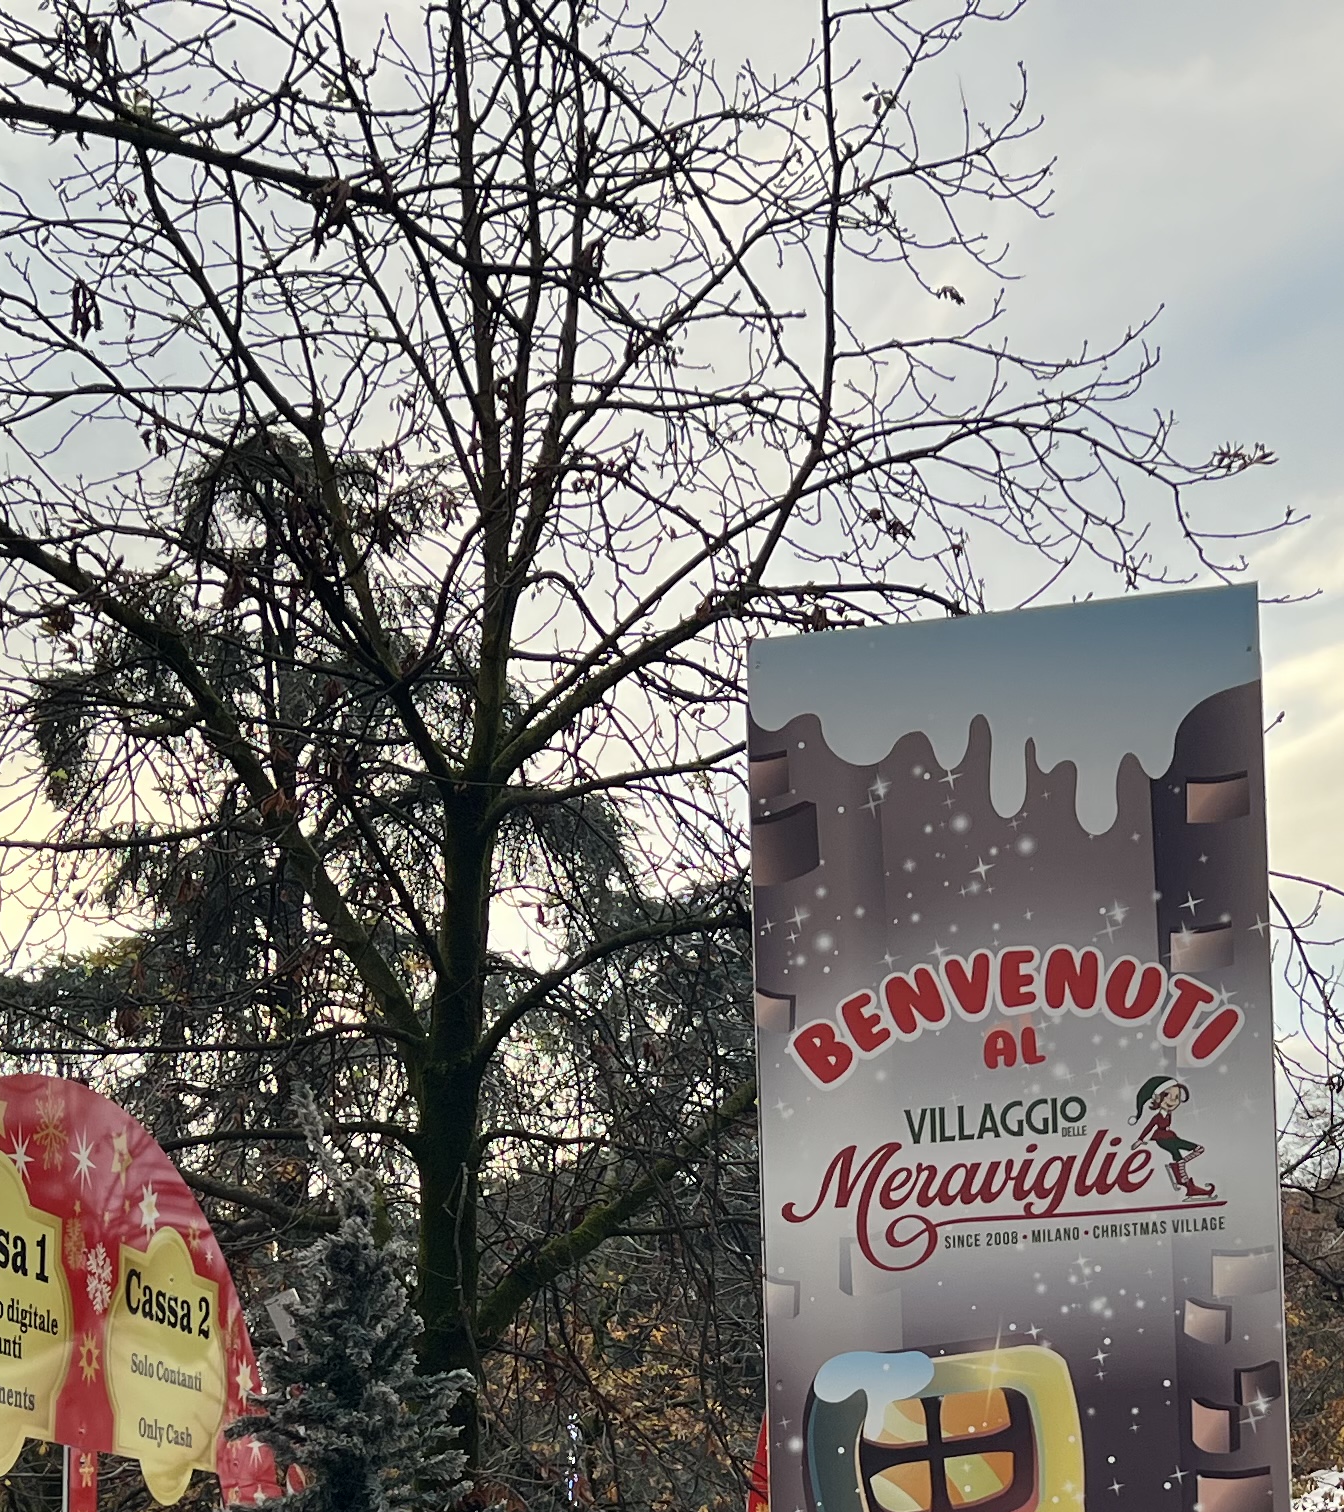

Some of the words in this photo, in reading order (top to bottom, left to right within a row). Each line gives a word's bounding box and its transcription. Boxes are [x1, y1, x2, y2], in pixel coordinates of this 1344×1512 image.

[791, 947, 1240, 1085] BENVENUTI
[983, 1026, 1047, 1070] AL
[903, 1096, 1087, 1145] VILLAGGIO
[1061, 1124, 1087, 1138] DELLE
[781, 1129, 1155, 1271] Meraviglie
[944, 1233, 982, 1250] SINCE
[986, 1230, 1019, 1247] 2008
[1031, 1226, 1081, 1244] MILANO
[1092, 1219, 1167, 1239] CHRISTMAS
[1171, 1216, 1226, 1234] VILLAGE
[35, 1233, 50, 1284] 1
[6, 1298, 59, 1336] digitale
[124, 1268, 193, 1335] Cassa
[198, 1296, 211, 1340] 2
[130, 1353, 155, 1379] Solo
[156, 1360, 203, 1392] Contanti
[138, 1417, 165, 1448] Only
[166, 1422, 193, 1449] Cash
